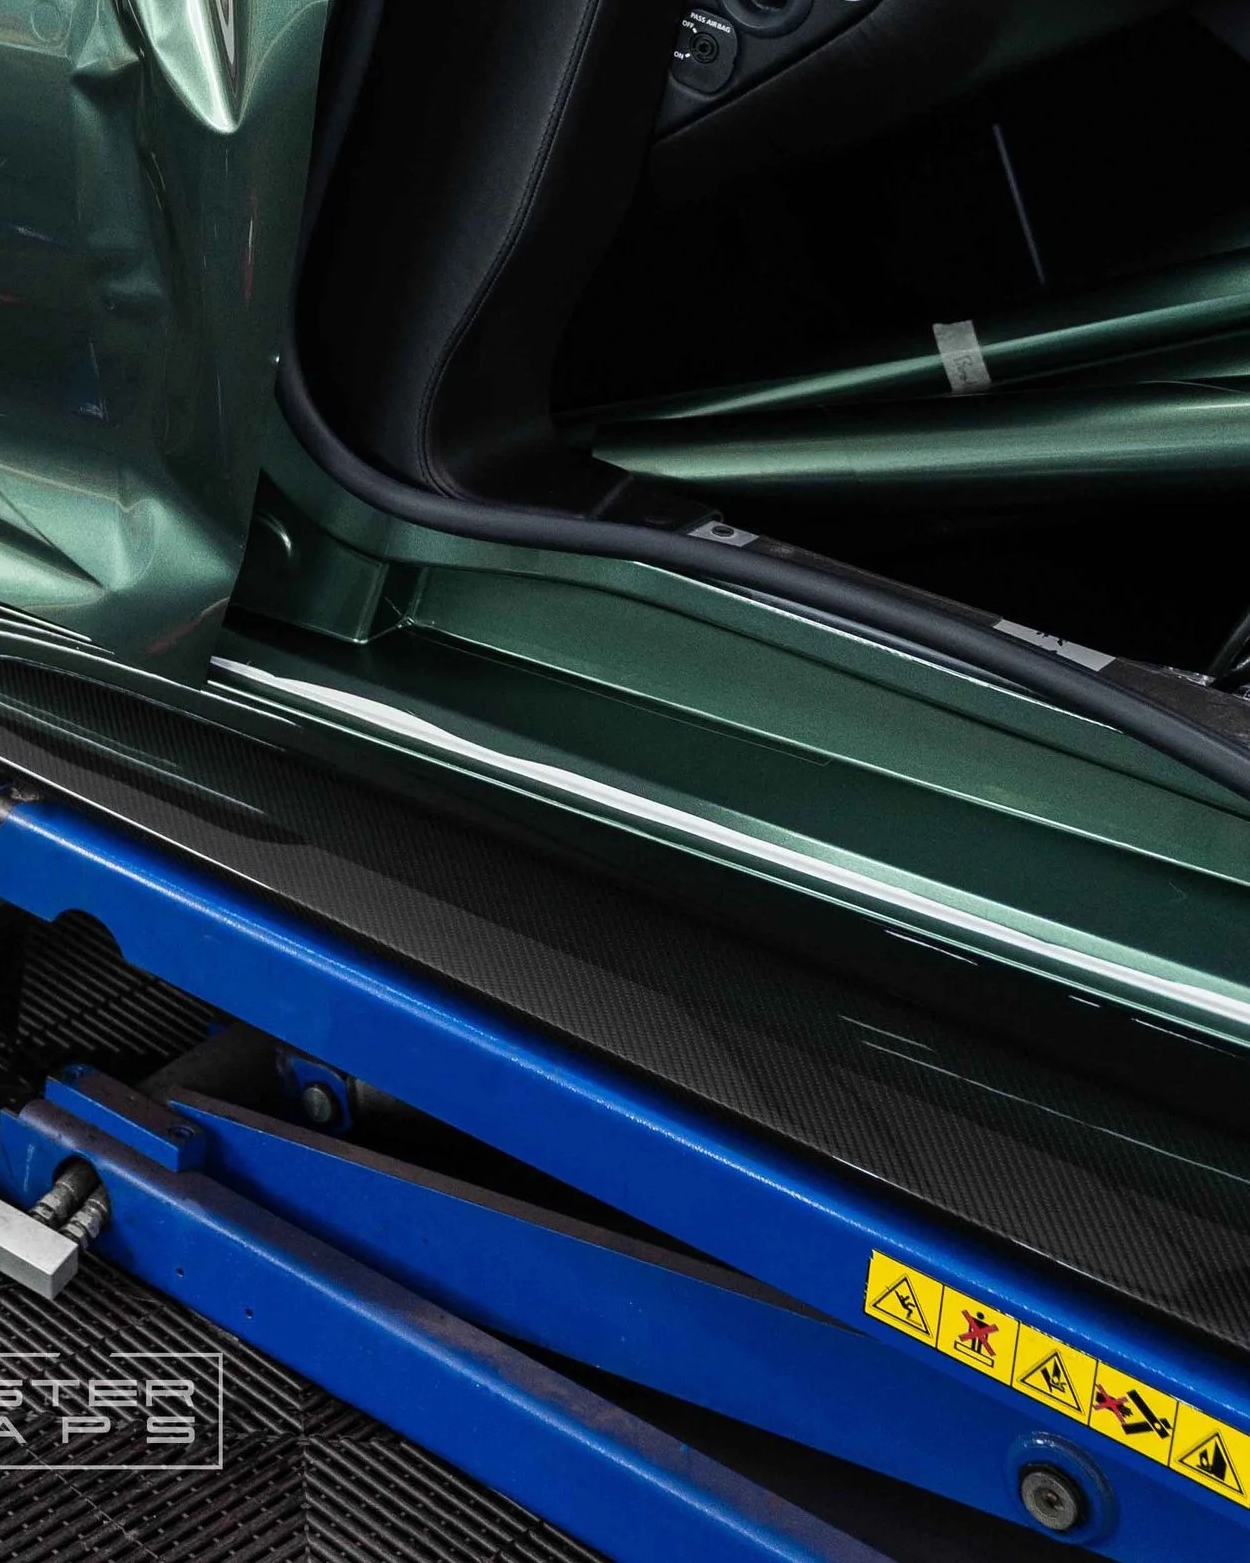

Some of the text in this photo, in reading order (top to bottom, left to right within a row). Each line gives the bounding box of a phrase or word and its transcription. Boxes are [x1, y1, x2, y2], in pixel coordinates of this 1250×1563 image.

[681, 19, 695, 28] OFF
[690, 12, 731, 33] PASS AIRBAG
[673, 50, 685, 60] ON
